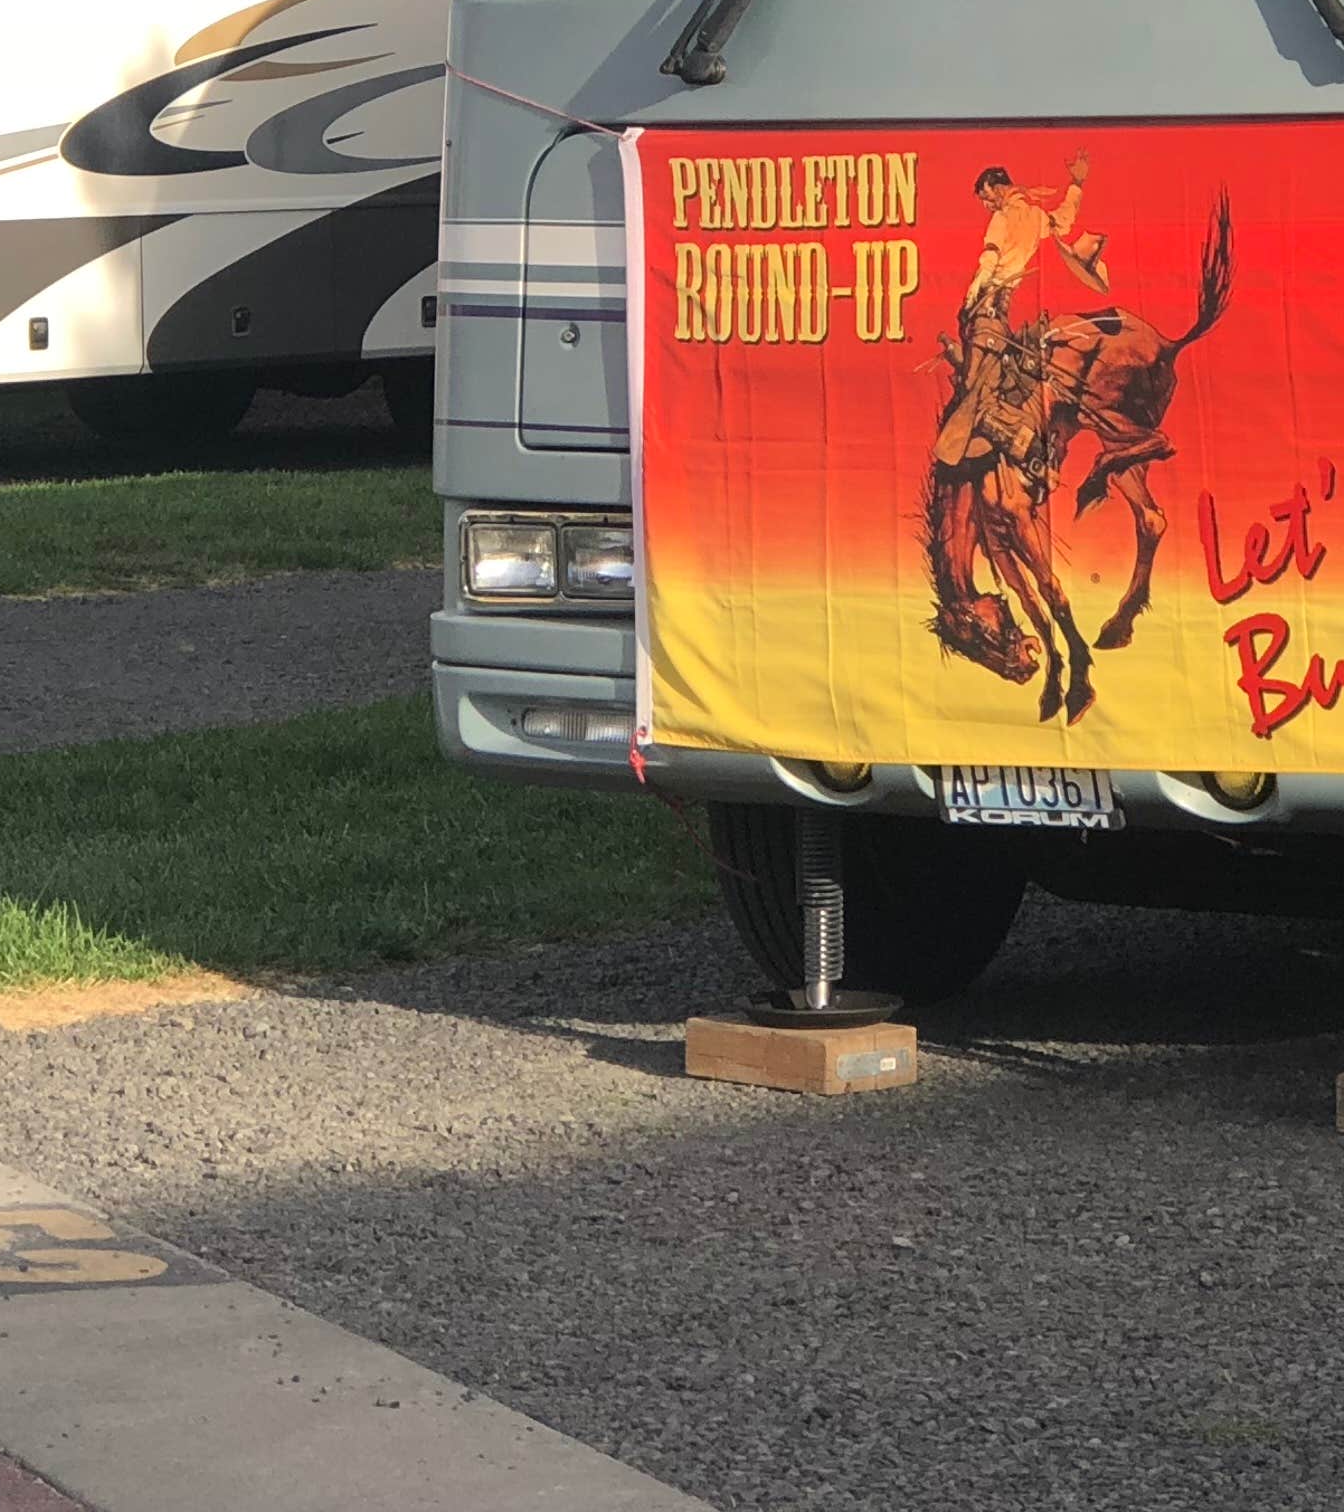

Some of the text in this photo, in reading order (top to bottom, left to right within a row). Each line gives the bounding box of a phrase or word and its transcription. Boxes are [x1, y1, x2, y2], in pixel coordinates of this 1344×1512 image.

[668, 152, 918, 230] PENDLETON
[673, 240, 920, 344] ROUND-UP
[948, 807, 1111, 829] KORUM
